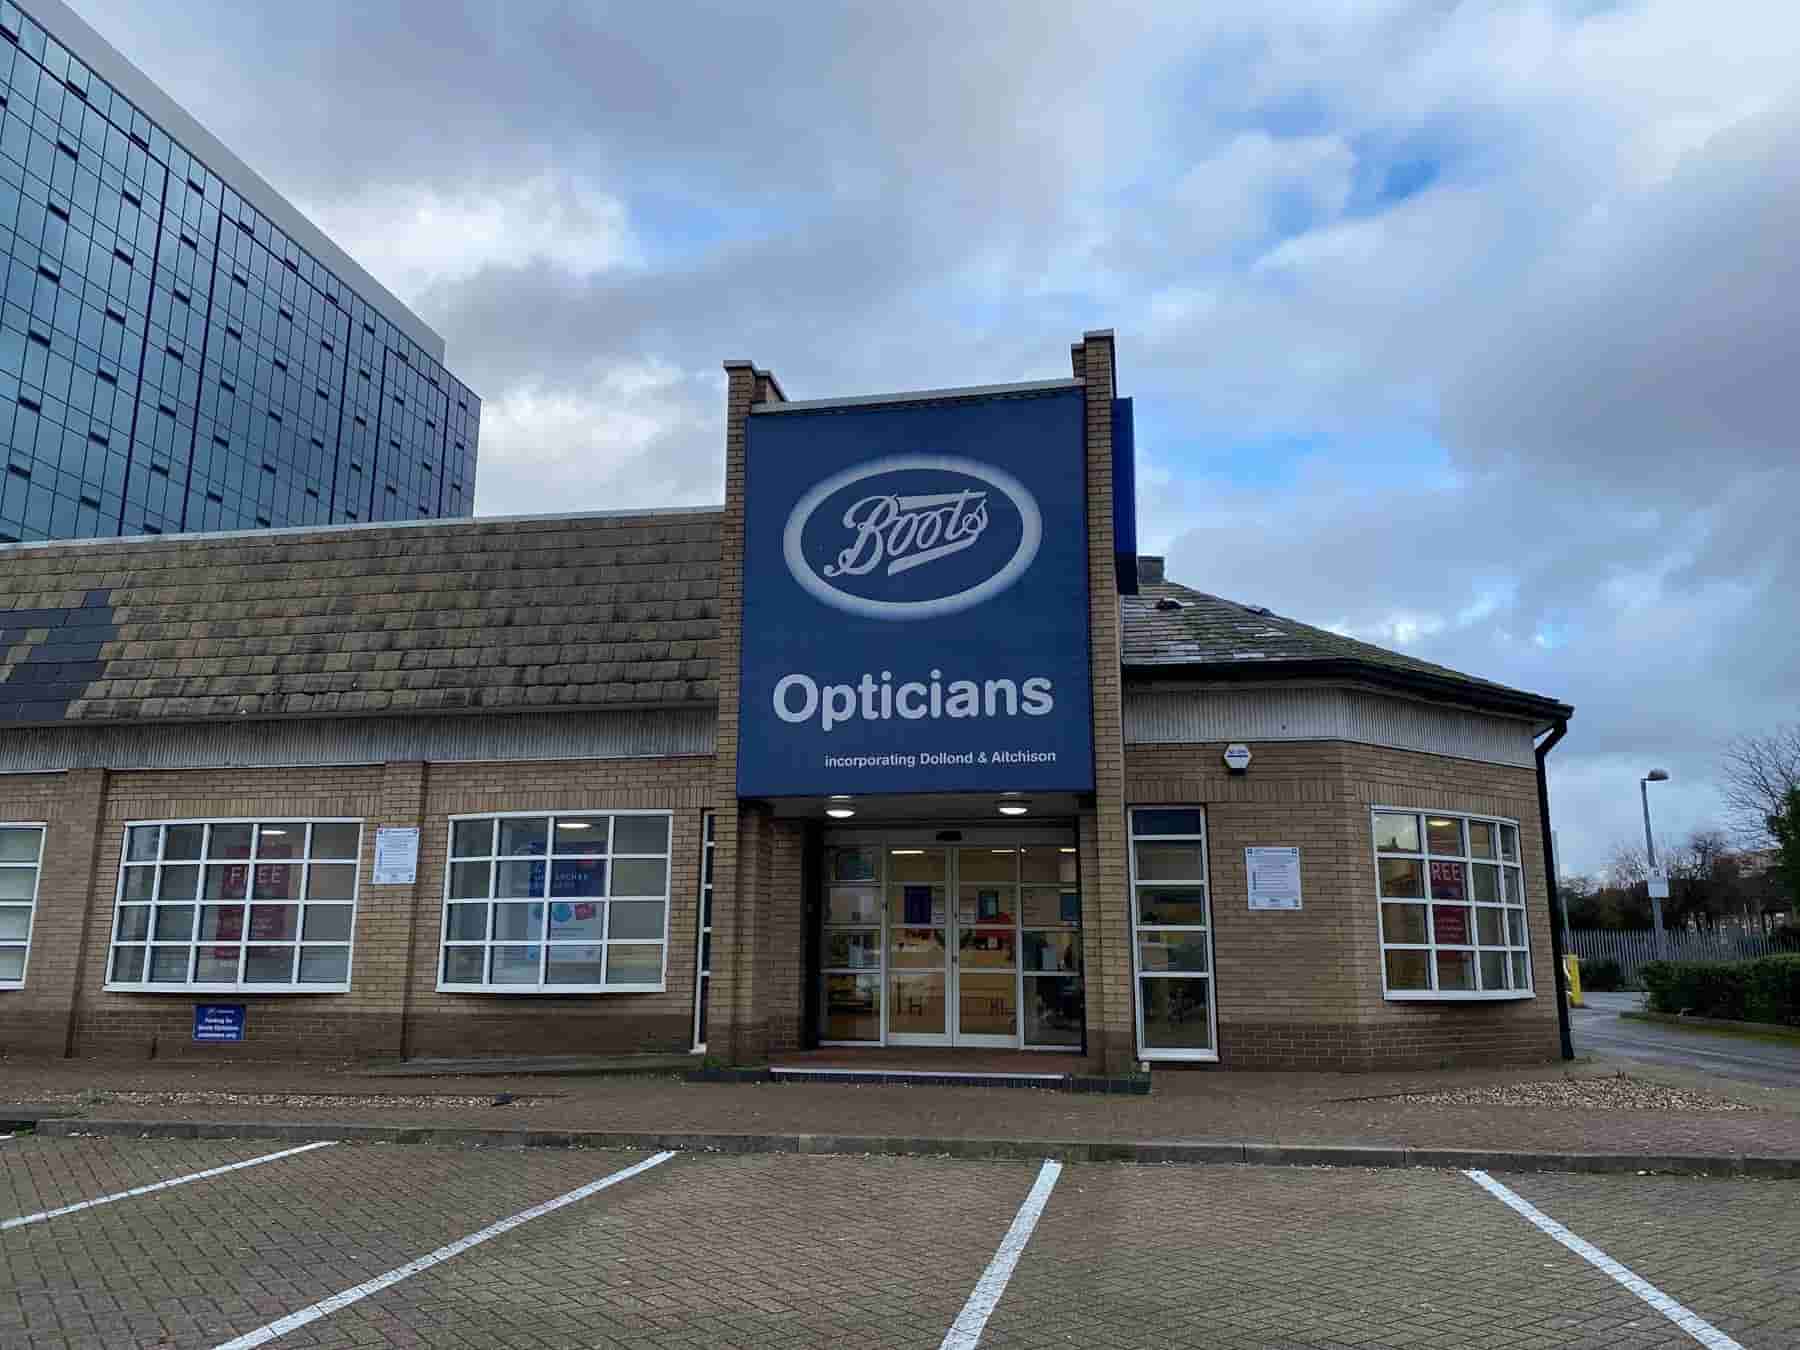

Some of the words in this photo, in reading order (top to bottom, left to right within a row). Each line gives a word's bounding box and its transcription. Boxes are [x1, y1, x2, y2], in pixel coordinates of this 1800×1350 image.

[824, 489, 989, 577] Boots
[773, 669, 1054, 732] Opticians
[824, 753, 916, 769] incorporating
[919, 752, 974, 766] Dollond
[977, 752, 988, 764] &
[991, 749, 1057, 764] Aitchison
